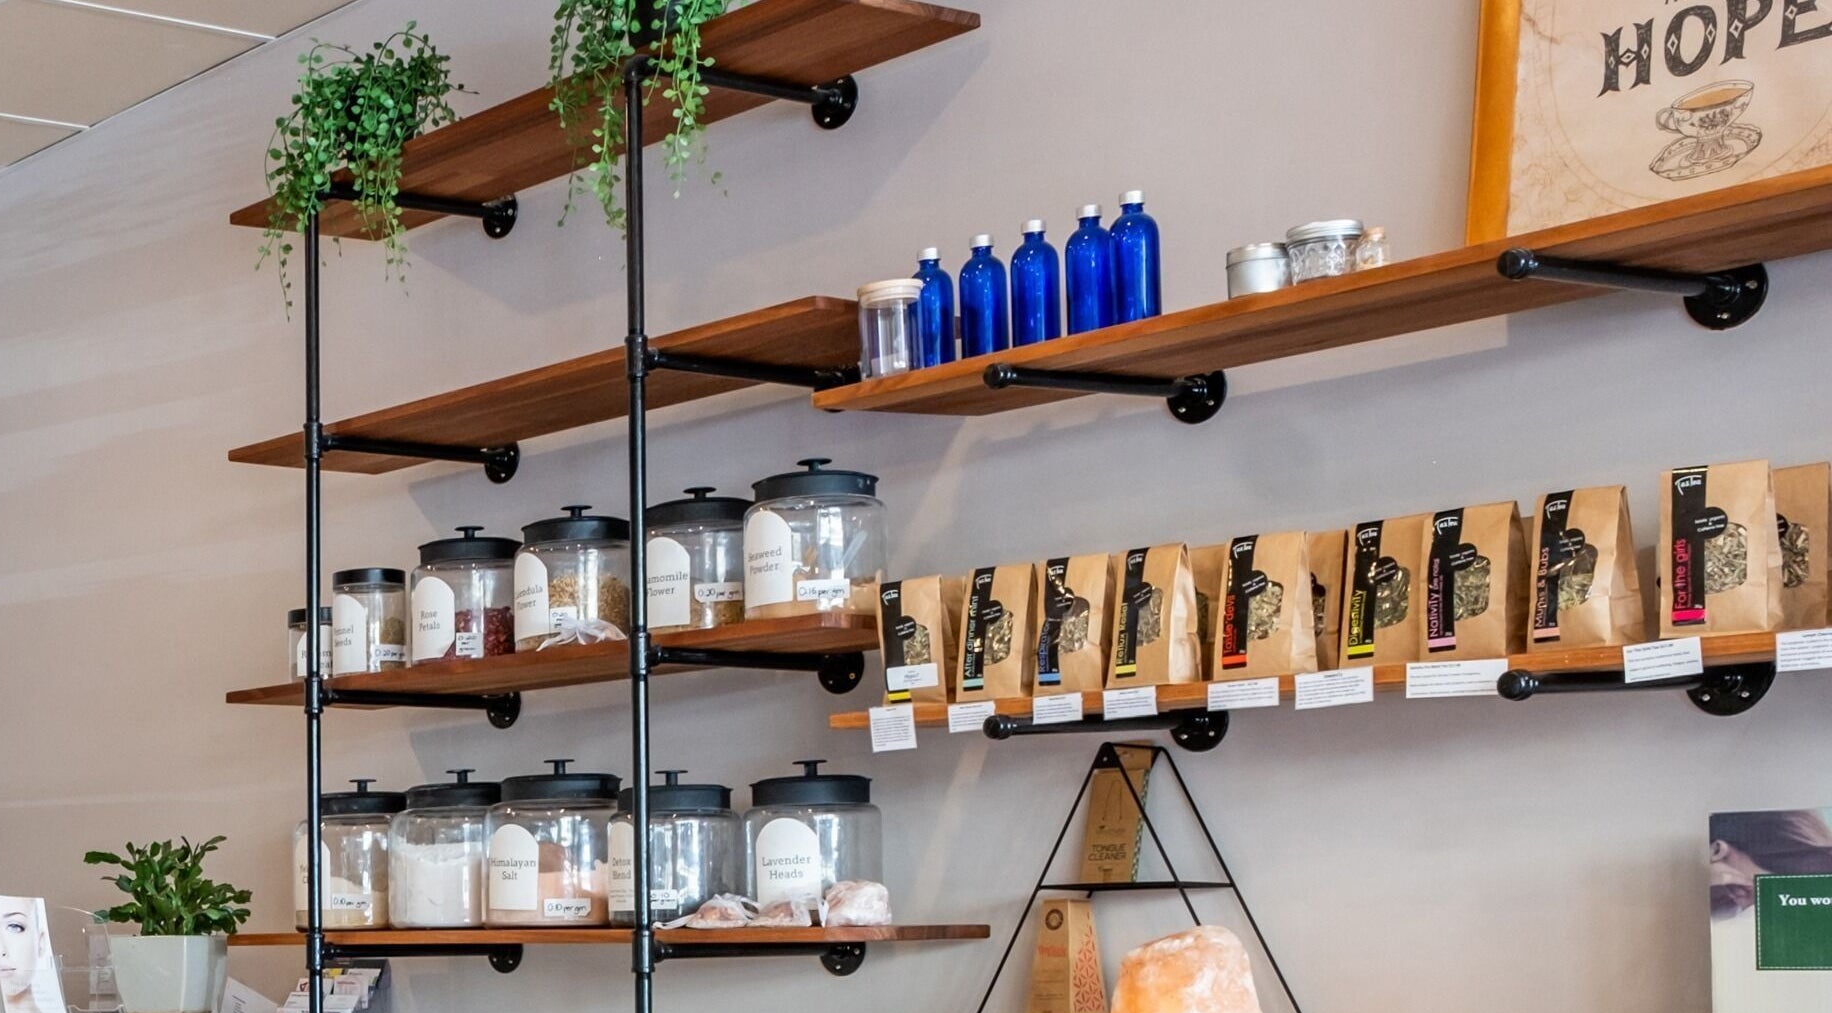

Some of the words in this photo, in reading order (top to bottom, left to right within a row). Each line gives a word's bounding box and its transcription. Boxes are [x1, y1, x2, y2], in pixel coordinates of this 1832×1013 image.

[1597, 0, 1832, 97] HOPE
[1673, 538, 1688, 563] girls
[749, 561, 779, 576] Powder
[647, 571, 689, 584] amomile
[1675, 591, 1686, 609] For
[1430, 588, 1441, 638] Nativity
[334, 625, 354, 636] ennel
[1091, 843, 1127, 853] TONGUE
[489, 857, 537, 870] Himalayan
[762, 854, 812, 867] Lavender
[1088, 852, 1127, 862] CLEANER
[502, 871, 519, 881] Salt
[769, 868, 804, 880] Heads
[1778, 894, 1807, 907] You
[1810, 896, 1832, 906] wo
